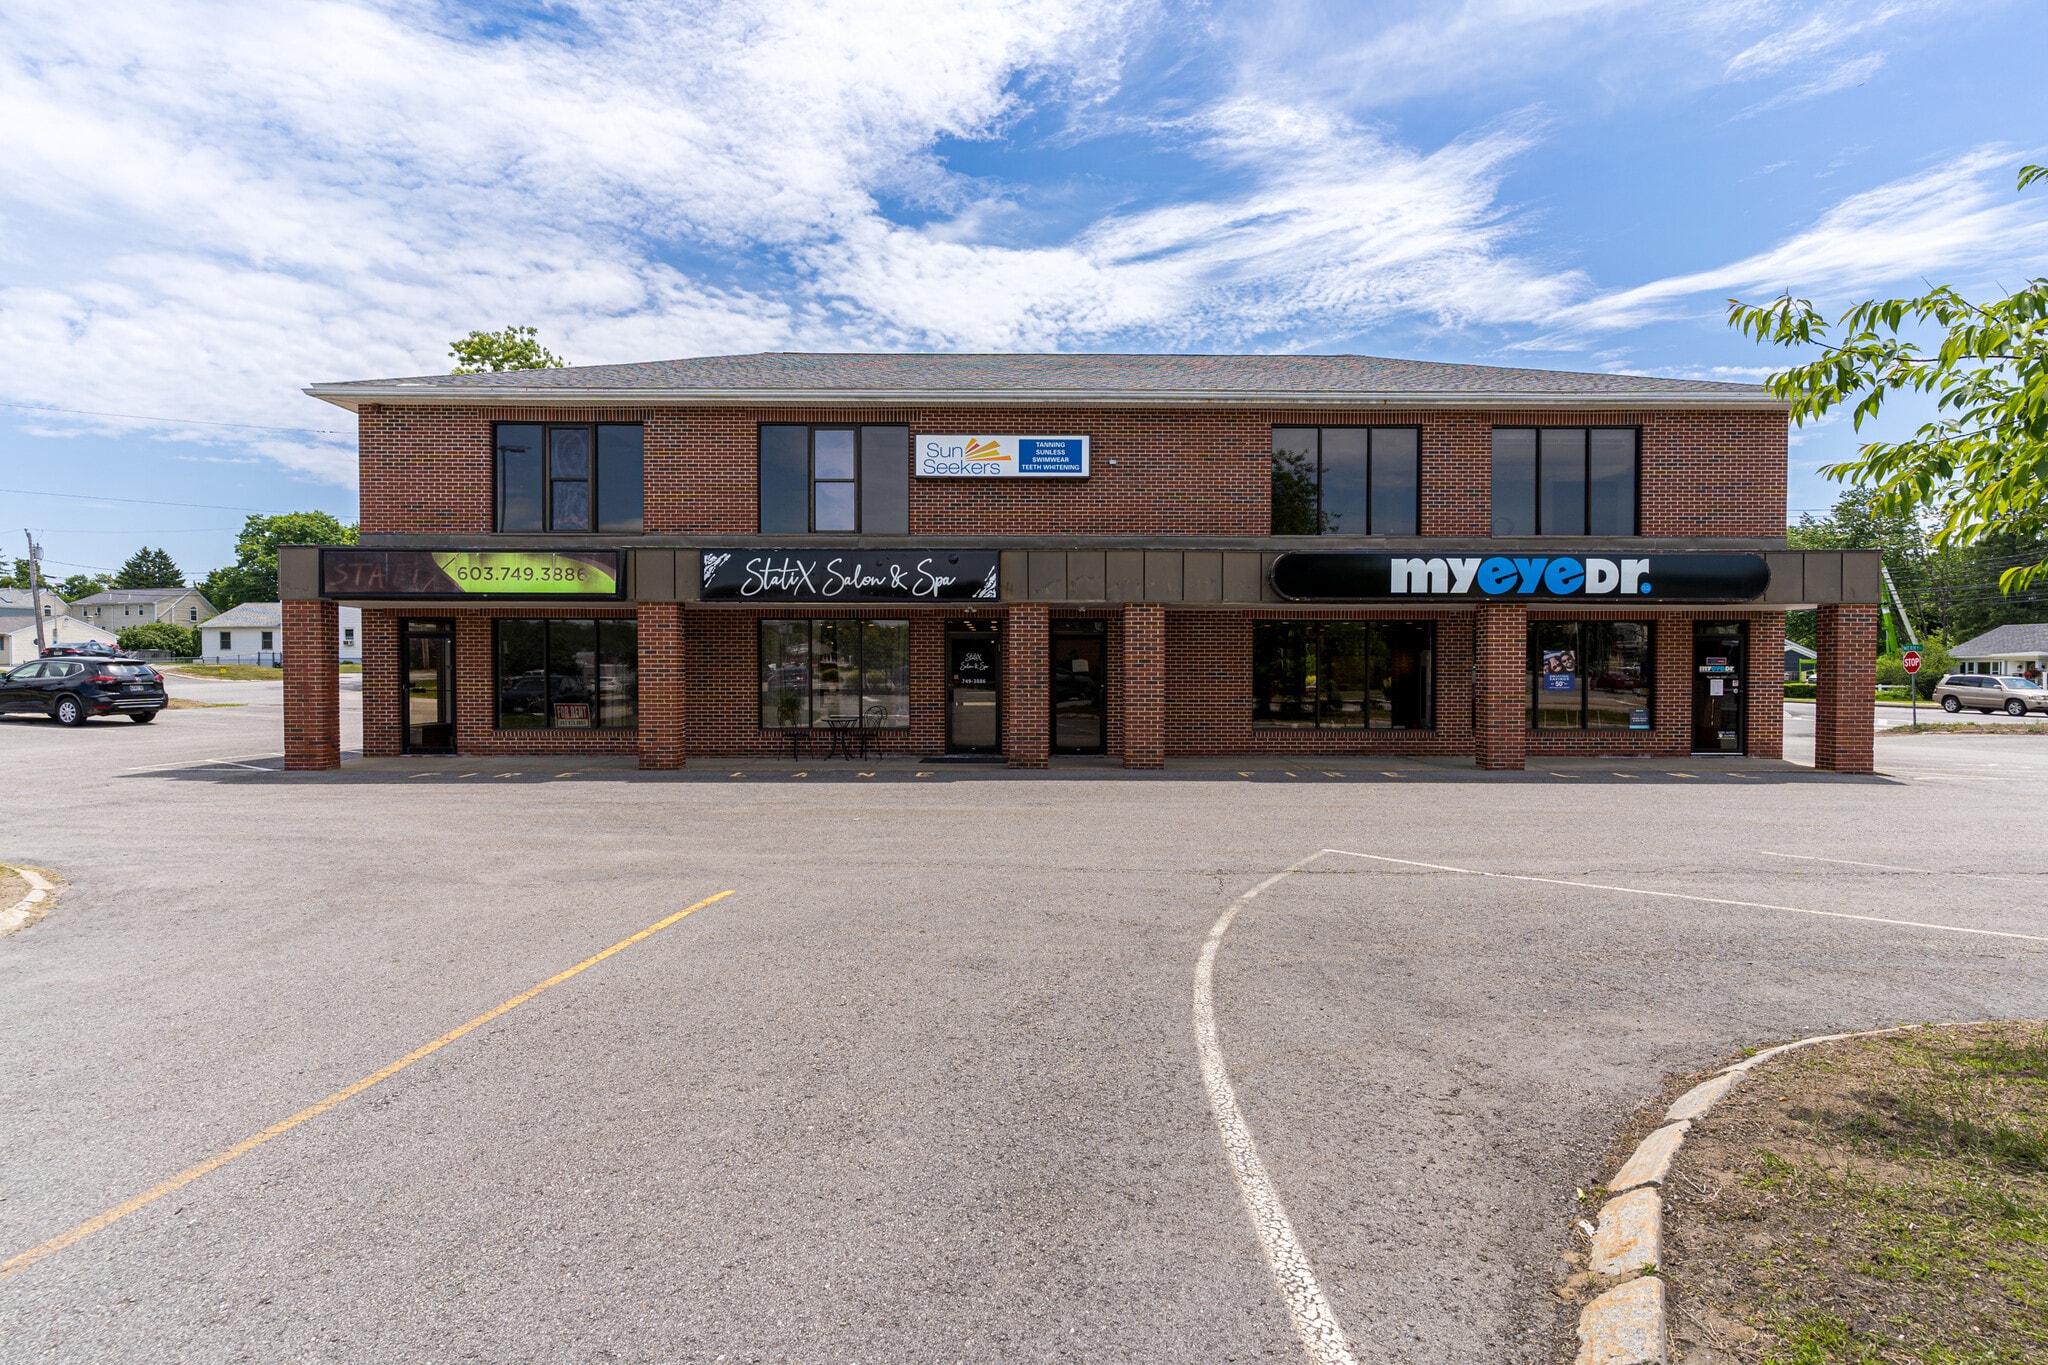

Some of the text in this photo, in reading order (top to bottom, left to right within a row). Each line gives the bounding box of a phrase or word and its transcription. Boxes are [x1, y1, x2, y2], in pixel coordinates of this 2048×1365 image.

[926, 442, 964, 458] Sun
[1035, 448, 1066, 456] SUNLESS
[923, 459, 1001, 475] Seekers
[457, 566, 588, 582] 603.749.3886
[740, 557, 956, 597] StatiX Salon & Spa
[1904, 658, 1919, 667] STOP
[557, 706, 587, 718] FOR RENT
